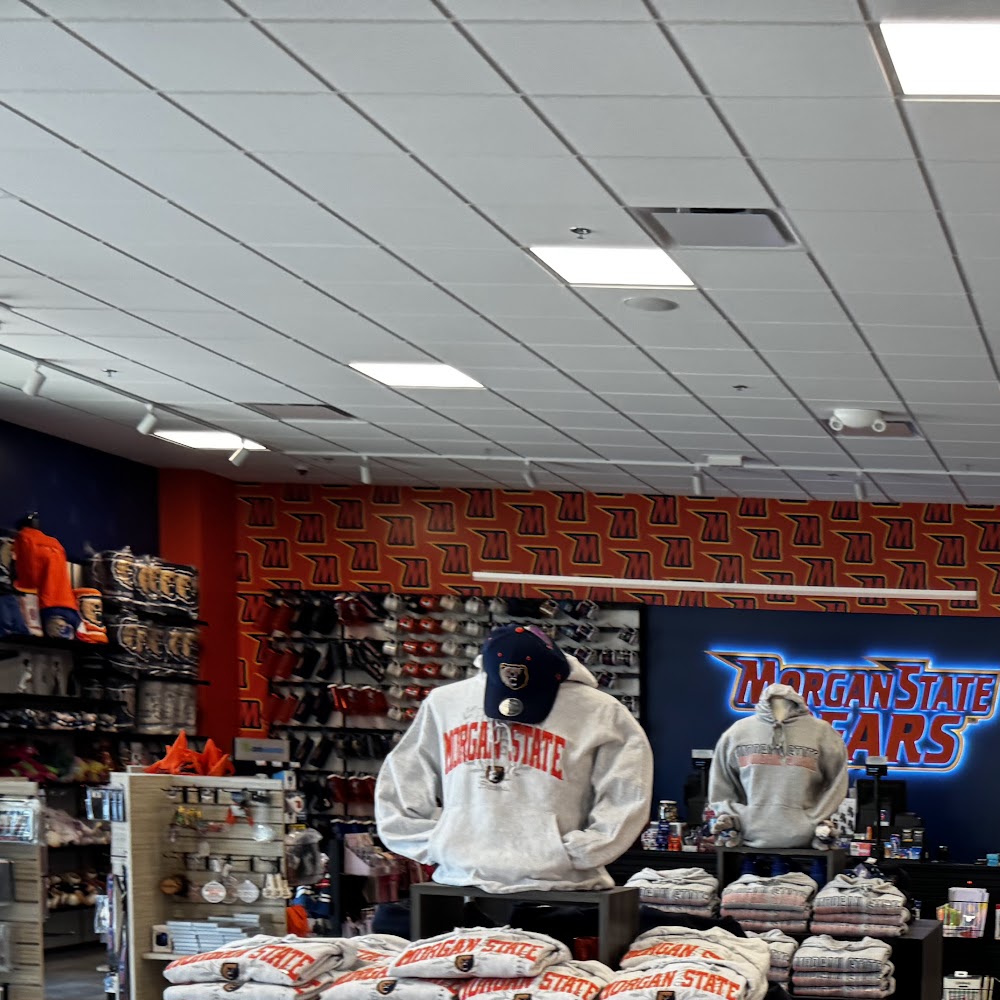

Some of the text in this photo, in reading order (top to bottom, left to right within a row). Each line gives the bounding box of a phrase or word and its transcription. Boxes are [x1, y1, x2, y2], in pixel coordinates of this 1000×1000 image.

[894, 665, 995, 712] STATE
[508, 723, 566, 780] STATE
[813, 711, 962, 764] EARS
[248, 944, 316, 981] STATE
[394, 938, 545, 967] MORGAN STATE
[602, 969, 678, 1000] MORGAN
